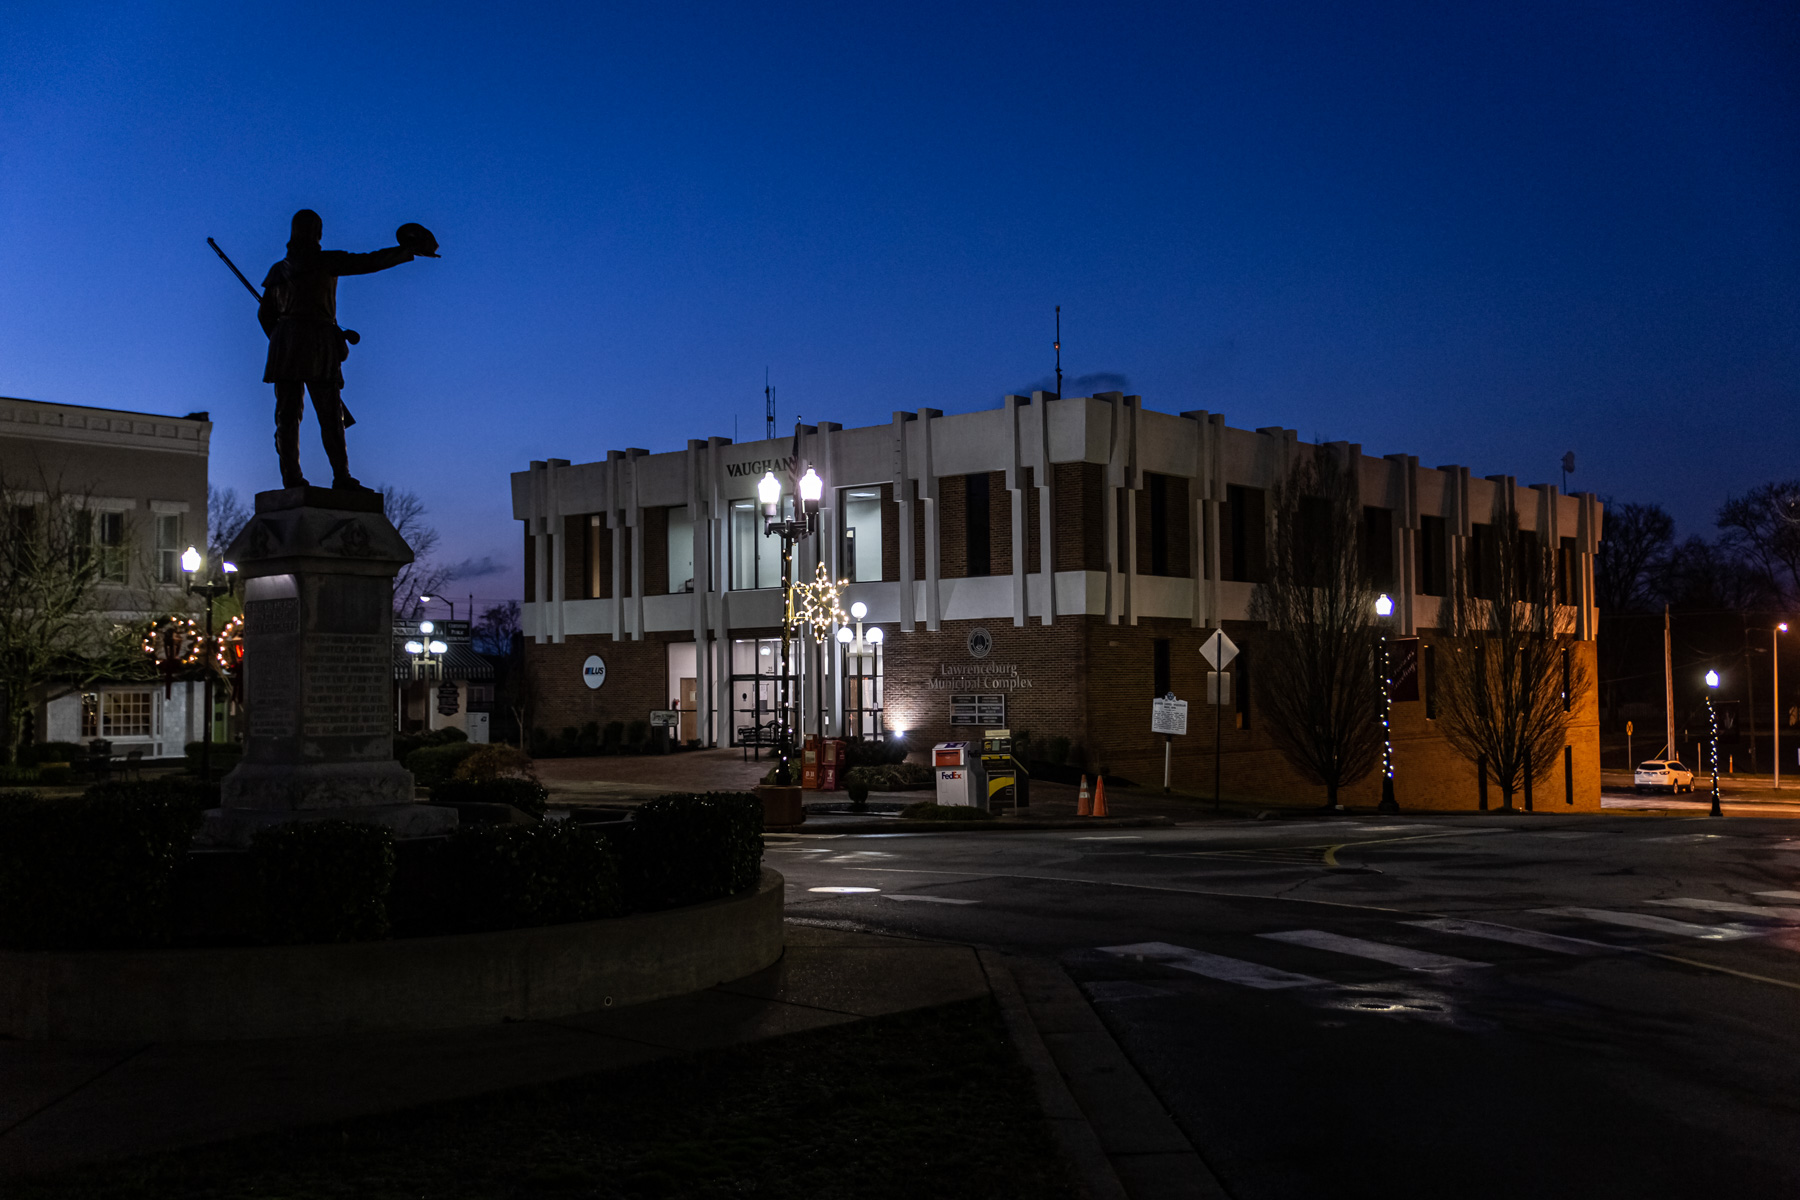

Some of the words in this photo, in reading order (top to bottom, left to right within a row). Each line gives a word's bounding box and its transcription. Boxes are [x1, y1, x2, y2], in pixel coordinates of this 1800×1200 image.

[726, 456, 797, 477] VAUGHAN
[941, 661, 1018, 678] Lawrenceburg
[928, 677, 980, 692] Municipal
[984, 676, 1033, 692] Complex
[941, 771, 962, 780] FedEx
